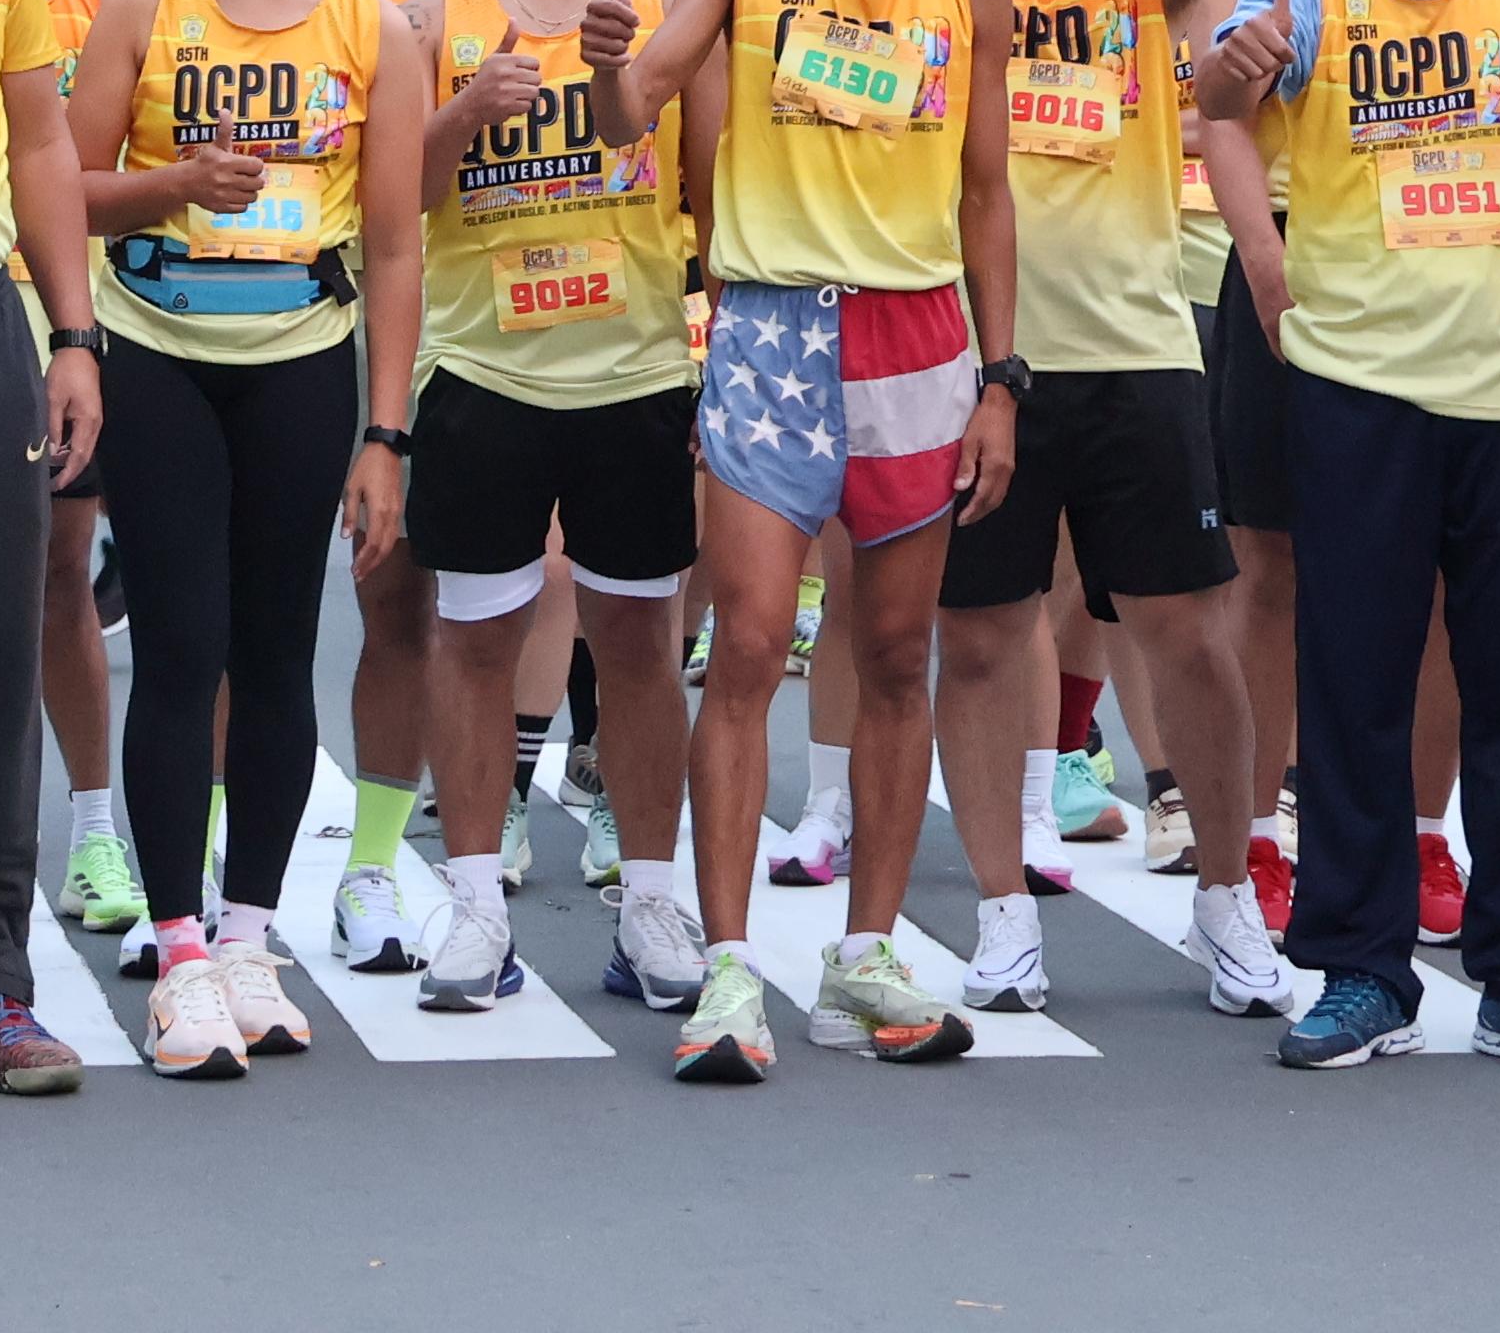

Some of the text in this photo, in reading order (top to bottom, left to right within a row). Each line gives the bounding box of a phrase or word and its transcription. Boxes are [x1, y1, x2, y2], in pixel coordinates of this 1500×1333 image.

[827, 20, 860, 41] QCPD
[1346, 24, 1377, 41] 85TH
[176, 46, 209, 63] 85TH
[1350, 31, 1471, 103] QCPD
[173, 62, 299, 124] QCPD
[800, 49, 898, 104] 6130
[1011, 91, 1104, 132] 9016
[1357, 92, 1468, 123] ANNIVERSARY
[180, 122, 292, 143] ANNIERSARY
[466, 155, 592, 189] ANNIVERSARY
[1413, 151, 1445, 167] QCPD
[1401, 181, 1500, 216] 9051
[511, 272, 609, 315] 9092
